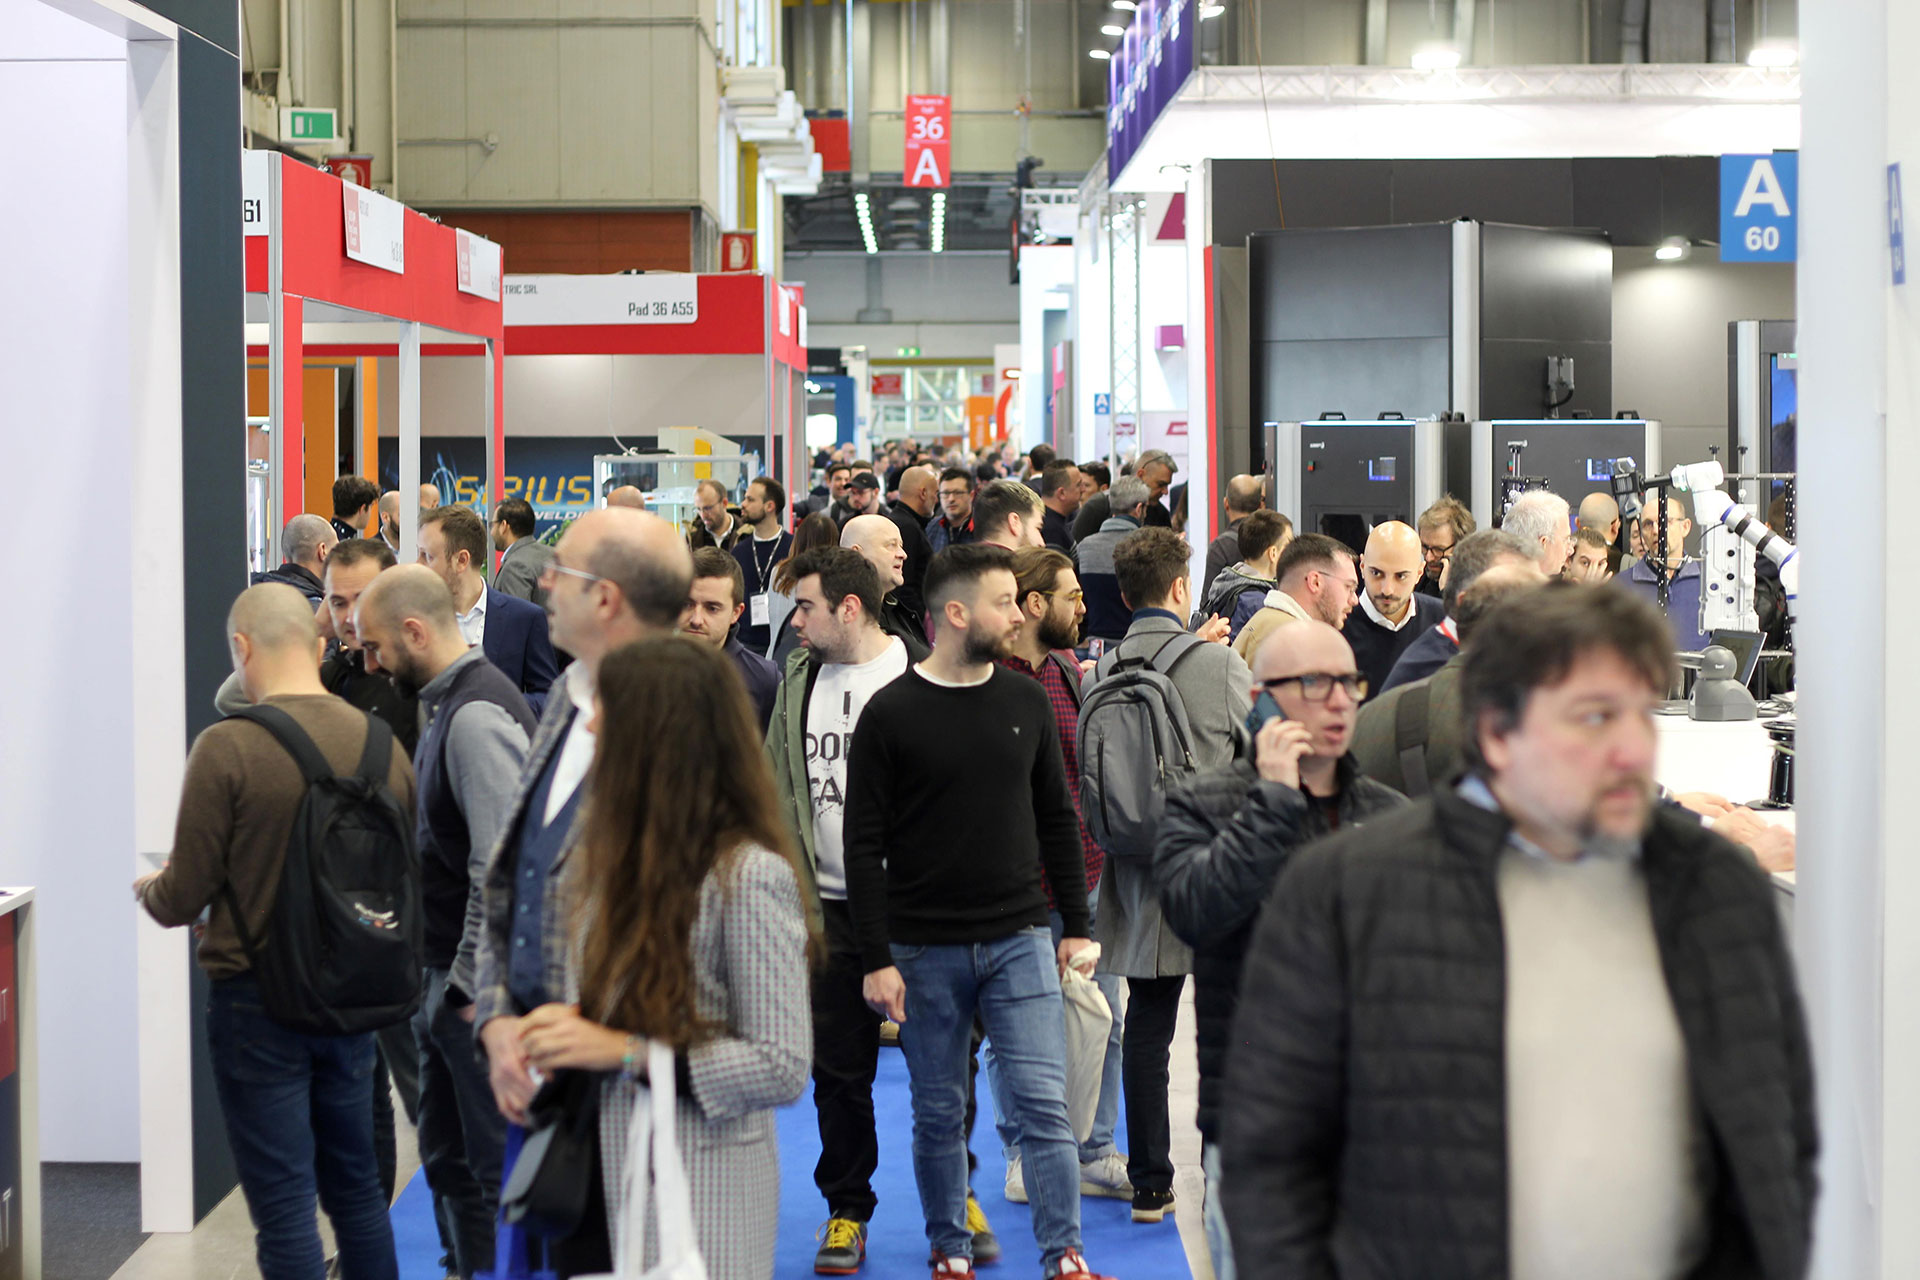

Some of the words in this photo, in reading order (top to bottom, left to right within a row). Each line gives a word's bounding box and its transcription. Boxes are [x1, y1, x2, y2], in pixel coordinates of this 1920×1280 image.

[912, 115, 944, 140] 36
[912, 148, 943, 186] A
[1733, 159, 1791, 217] A
[244, 199, 261, 222] 61
[1745, 226, 1780, 251] 60
[503, 284, 522, 295] TRIC
[628, 302, 649, 316] Pad
[652, 302, 668, 316] 36
[671, 302, 694, 316] A55
